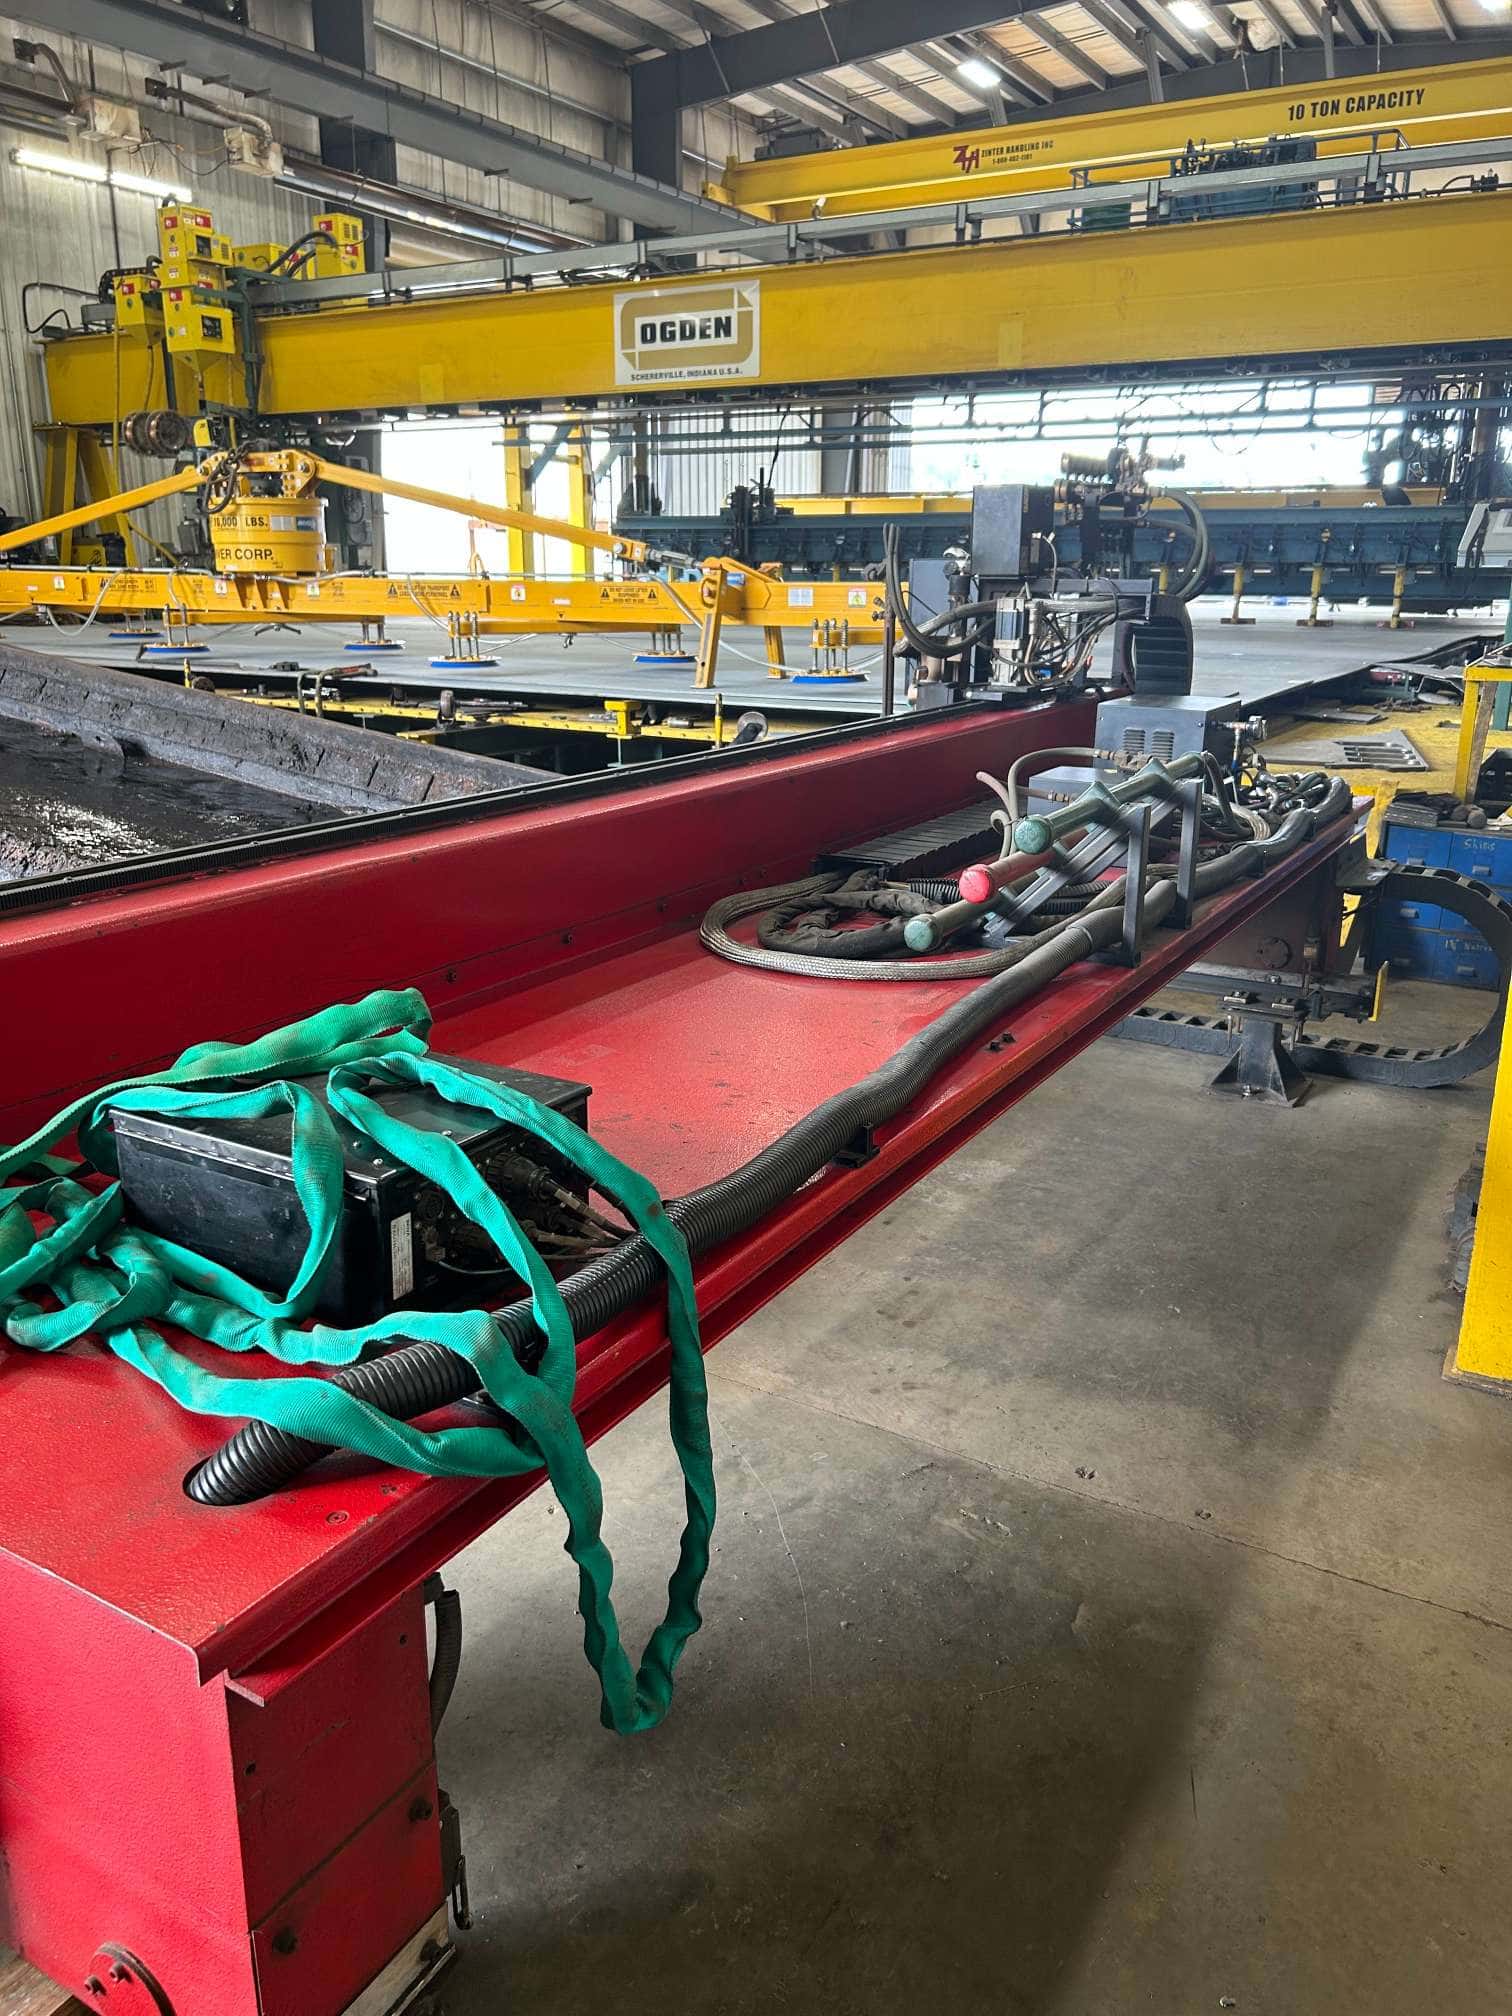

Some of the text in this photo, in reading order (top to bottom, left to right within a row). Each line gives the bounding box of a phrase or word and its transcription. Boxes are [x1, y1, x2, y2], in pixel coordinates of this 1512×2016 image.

[1288, 88, 1425, 120] 10 TON CAPACITY
[1006, 142, 1039, 154] HANDLING
[640, 316, 732, 345] OGDEN
[630, 367, 743, 382] SCHERERVILLE, INDIANA U.S.A.
[245, 516, 269, 527] LBS.
[234, 548, 274, 561] CORP.
